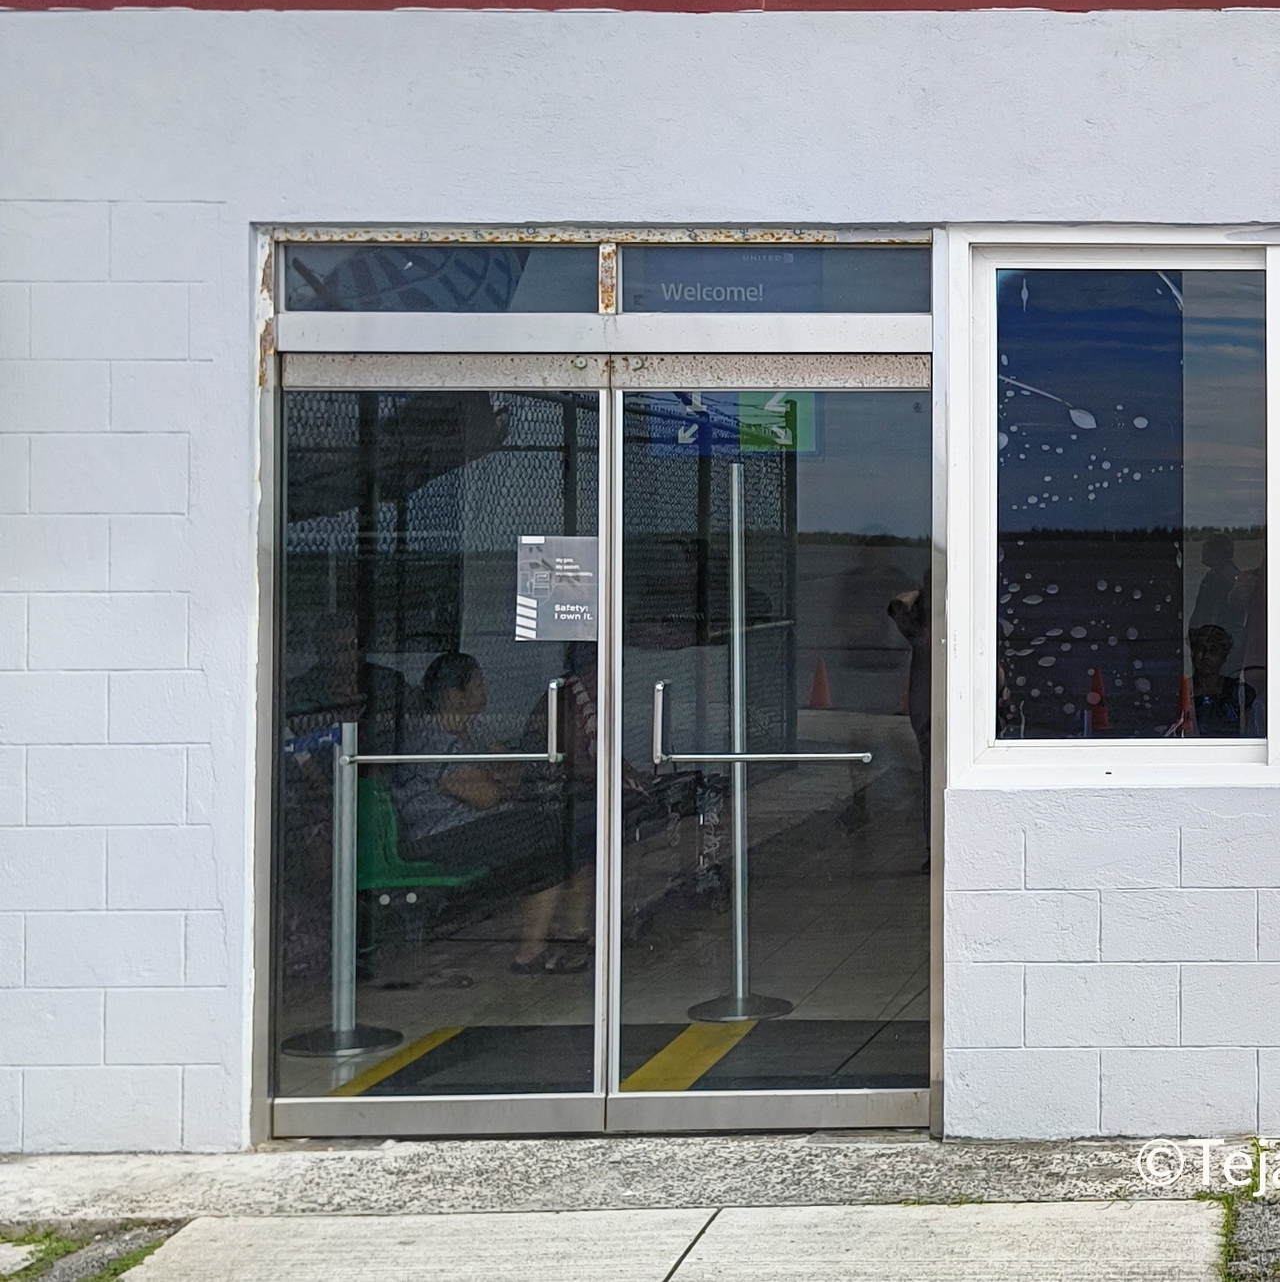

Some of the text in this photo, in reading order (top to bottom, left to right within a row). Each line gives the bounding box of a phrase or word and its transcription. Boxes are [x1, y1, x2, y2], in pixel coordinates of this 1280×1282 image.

[660, 282, 764, 302] Welcome!
[554, 604, 589, 613] Safety:
[554, 612, 558, 620] I
